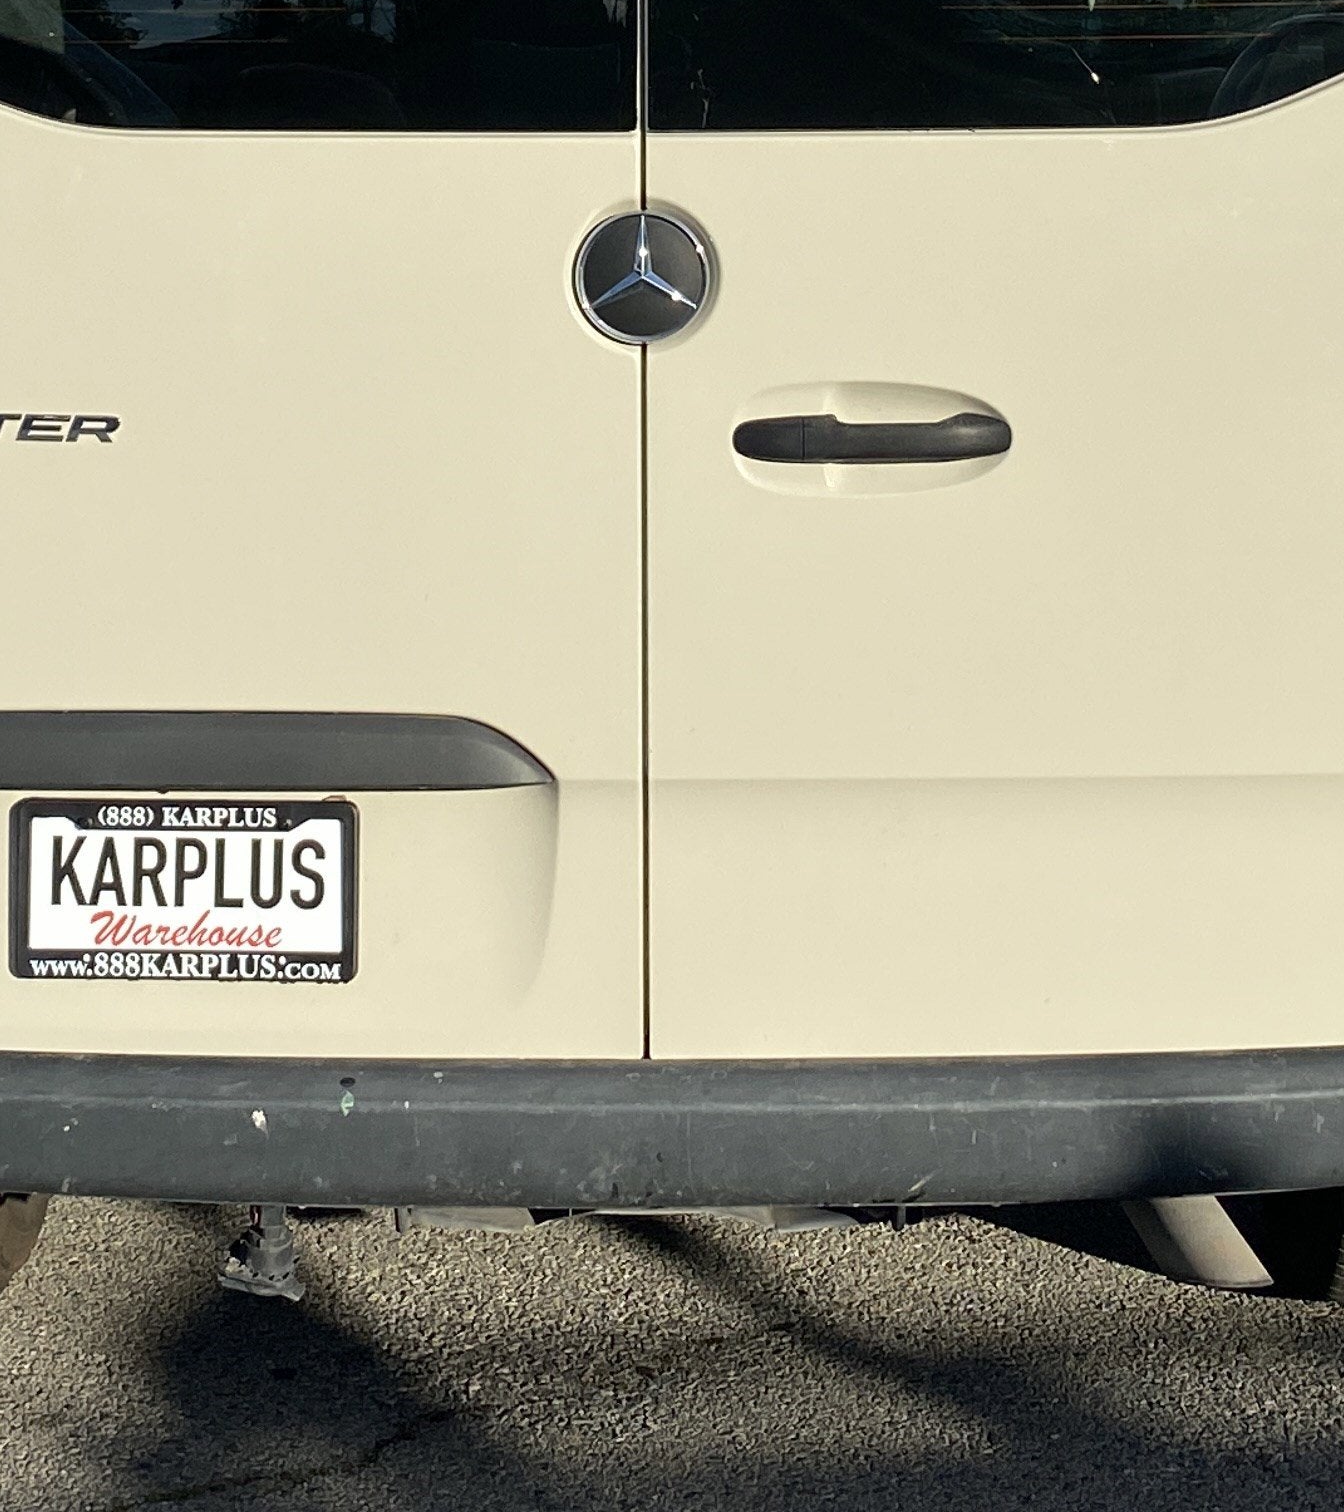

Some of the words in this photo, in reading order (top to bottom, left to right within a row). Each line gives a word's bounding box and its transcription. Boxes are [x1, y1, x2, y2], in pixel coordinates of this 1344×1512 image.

[96, 806, 155, 829] (888)
[160, 806, 277, 829] KARPLUS
[50, 834, 326, 910] KARPLUS
[89, 909, 283, 949] Warehouse
